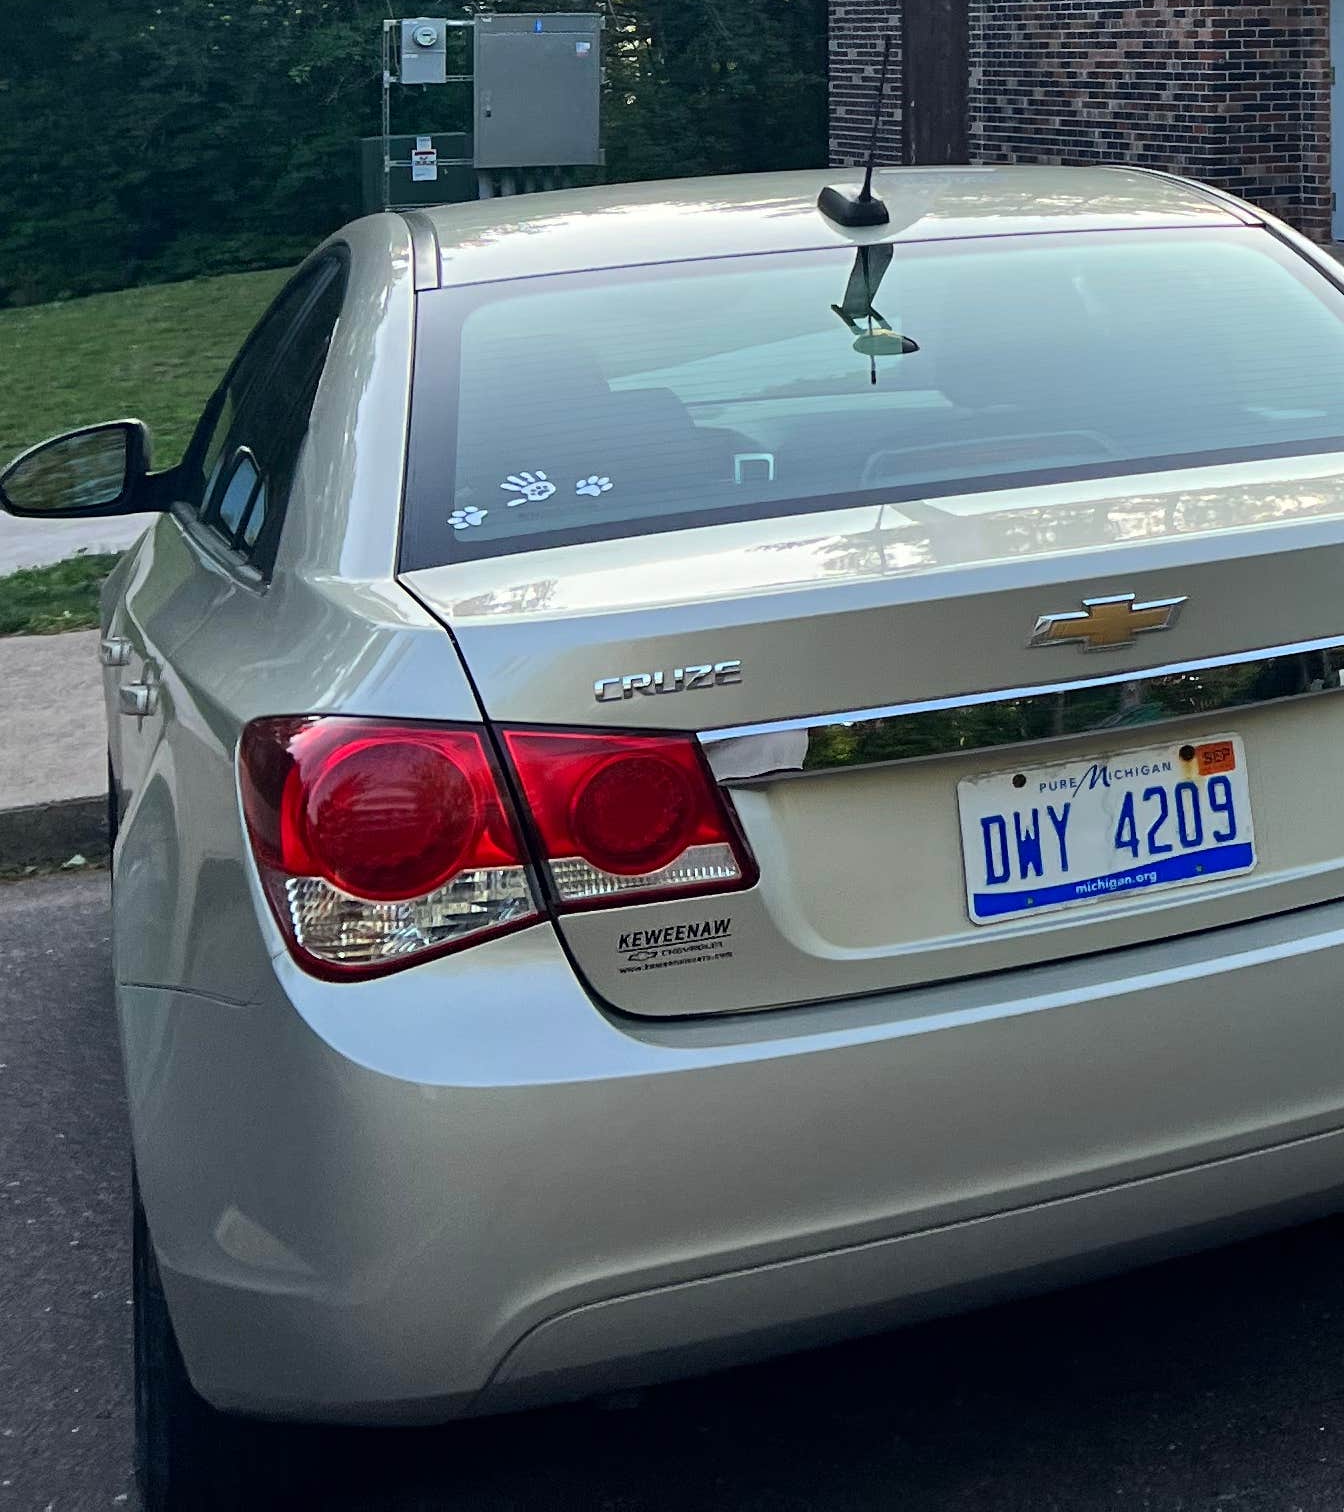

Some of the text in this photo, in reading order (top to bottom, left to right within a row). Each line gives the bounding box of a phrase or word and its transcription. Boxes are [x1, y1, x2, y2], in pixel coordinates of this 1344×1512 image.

[594, 659, 742, 702] CRUZE
[1039, 777, 1077, 793] PURE
[980, 775, 1237, 885] DWY 4209
[1075, 870, 1158, 895] michigan.org
[618, 918, 731, 949] KEWEENAW
